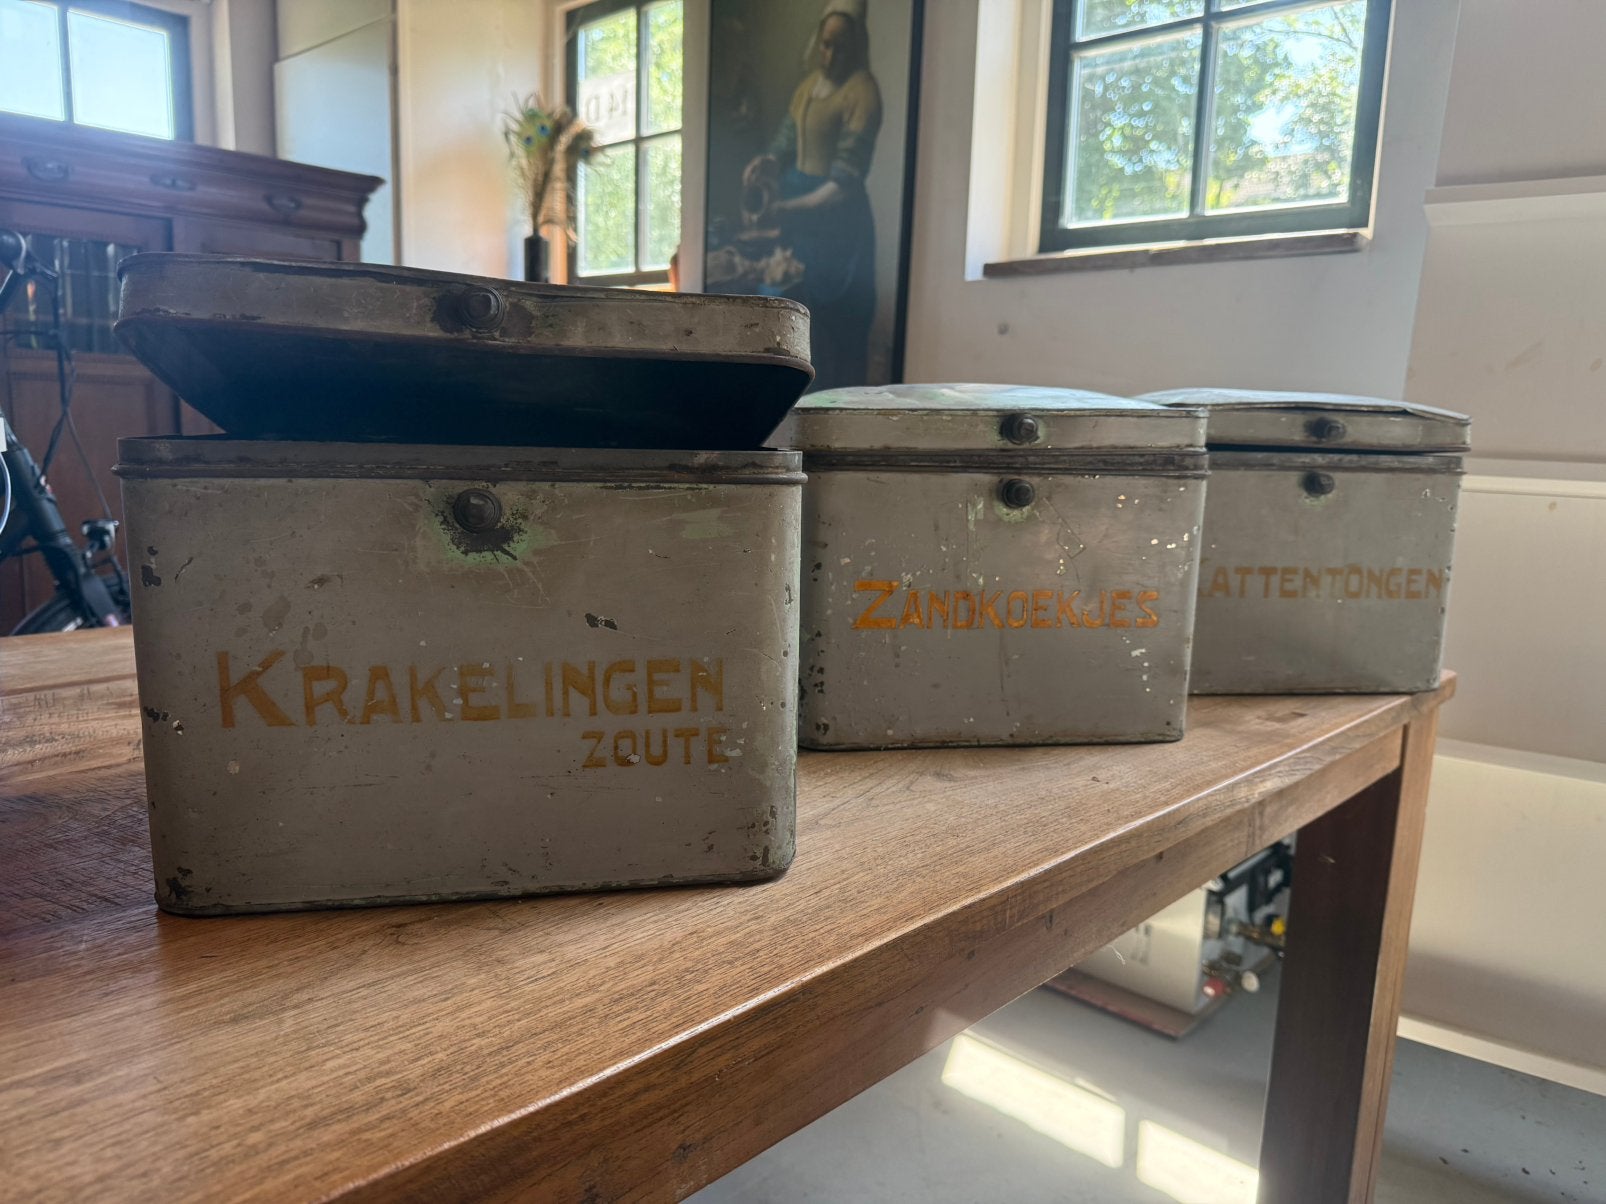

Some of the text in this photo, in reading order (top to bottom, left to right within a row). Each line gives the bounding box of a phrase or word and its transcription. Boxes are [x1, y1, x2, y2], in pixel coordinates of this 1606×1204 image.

[1198, 560, 1443, 600] ATTENTONGEN
[852, 579, 1160, 630] ZANDKOEKJES
[216, 650, 724, 728] KRAKELINGEN
[581, 726, 730, 769] ZOUTE
